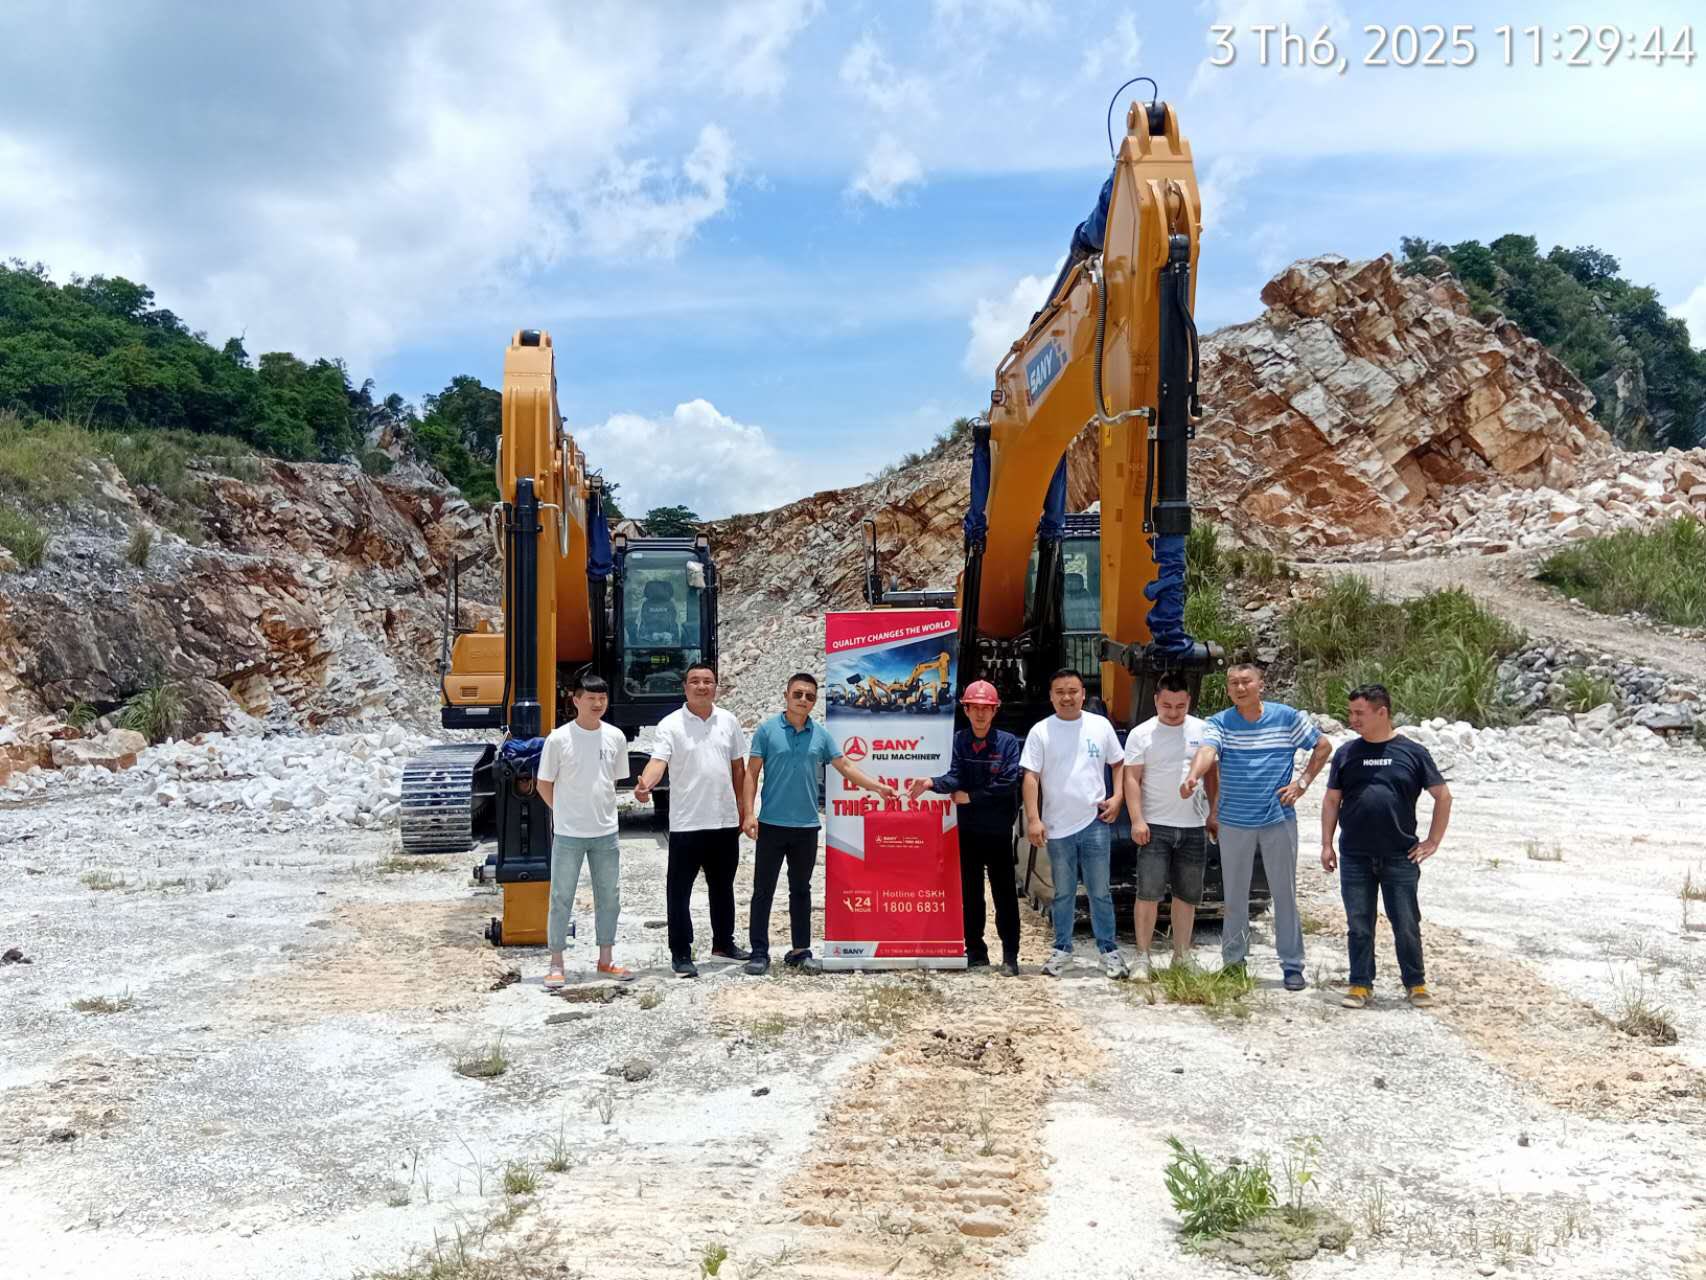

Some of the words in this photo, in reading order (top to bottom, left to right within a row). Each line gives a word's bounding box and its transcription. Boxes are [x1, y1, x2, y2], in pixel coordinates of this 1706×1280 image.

[1030, 350, 1053, 394] SANY
[832, 636, 866, 649] QUALITY
[868, 629, 904, 642] CHANGES
[905, 625, 921, 635] THE
[921, 620, 951, 632] WORLD
[872, 739, 919, 751] SANY
[1086, 738, 1100, 758] LA
[891, 753, 940, 761] MACHINERY
[1363, 758, 1392, 766] HONEST
[882, 890, 915, 898] Hotline
[918, 890, 945, 898] CSKH
[855, 897, 872, 907] 24
[883, 902, 912, 912] 1800
[917, 902, 945, 912] 6831
